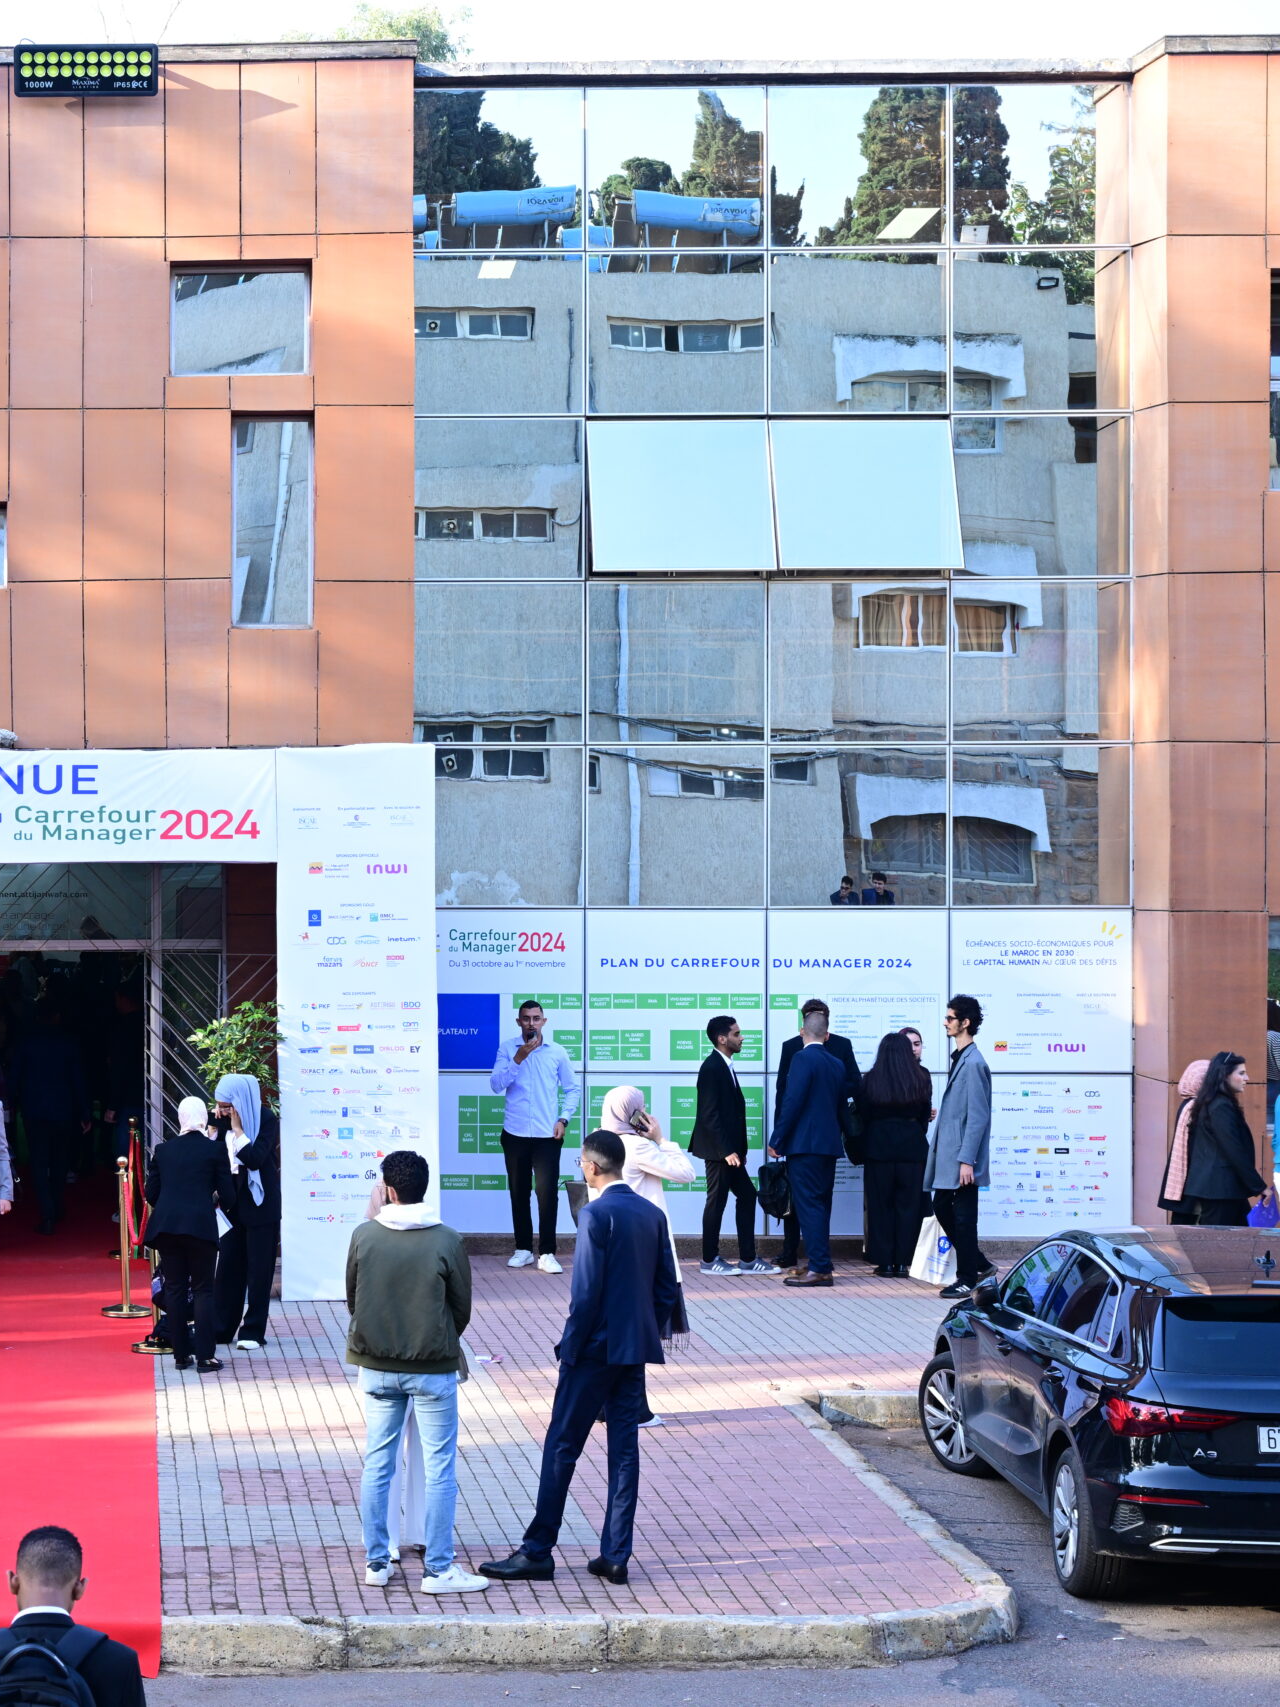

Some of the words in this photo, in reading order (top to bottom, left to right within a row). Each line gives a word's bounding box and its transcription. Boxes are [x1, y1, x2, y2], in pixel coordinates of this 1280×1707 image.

[24, 81, 54, 89] 1000W
[14, 805, 156, 825] Carrefour
[160, 808, 260, 840] 2024
[14, 829, 33, 841] du
[42, 825, 156, 845] Manager
[449, 929, 517, 941] Carrefour
[517, 932, 566, 952] 2024
[966, 939, 1007, 948] ÉCHÉANCES
[1009, 939, 1091, 947] SOCIO-ÉCONOMIQUES
[462, 942, 517, 955] Manager
[449, 960, 460, 968] Du
[462, 960, 469, 968] 31
[471, 960, 502, 968] octobre
[525, 960, 566, 968] novembre
[601, 958, 639, 968] PLAN
[645, 958, 665, 968] DU
[671, 958, 760, 968] CARREFOUR
[773, 958, 793, 968] DU
[799, 958, 872, 968] MANAGER
[878, 958, 912, 968] 2024
[1095, 957, 1117, 966] DÉFIS
[437, 1028, 468, 1036] PLATEAU
[1267, 1428, 1280, 1449] 6
[1193, 1447, 1218, 1458] A3
